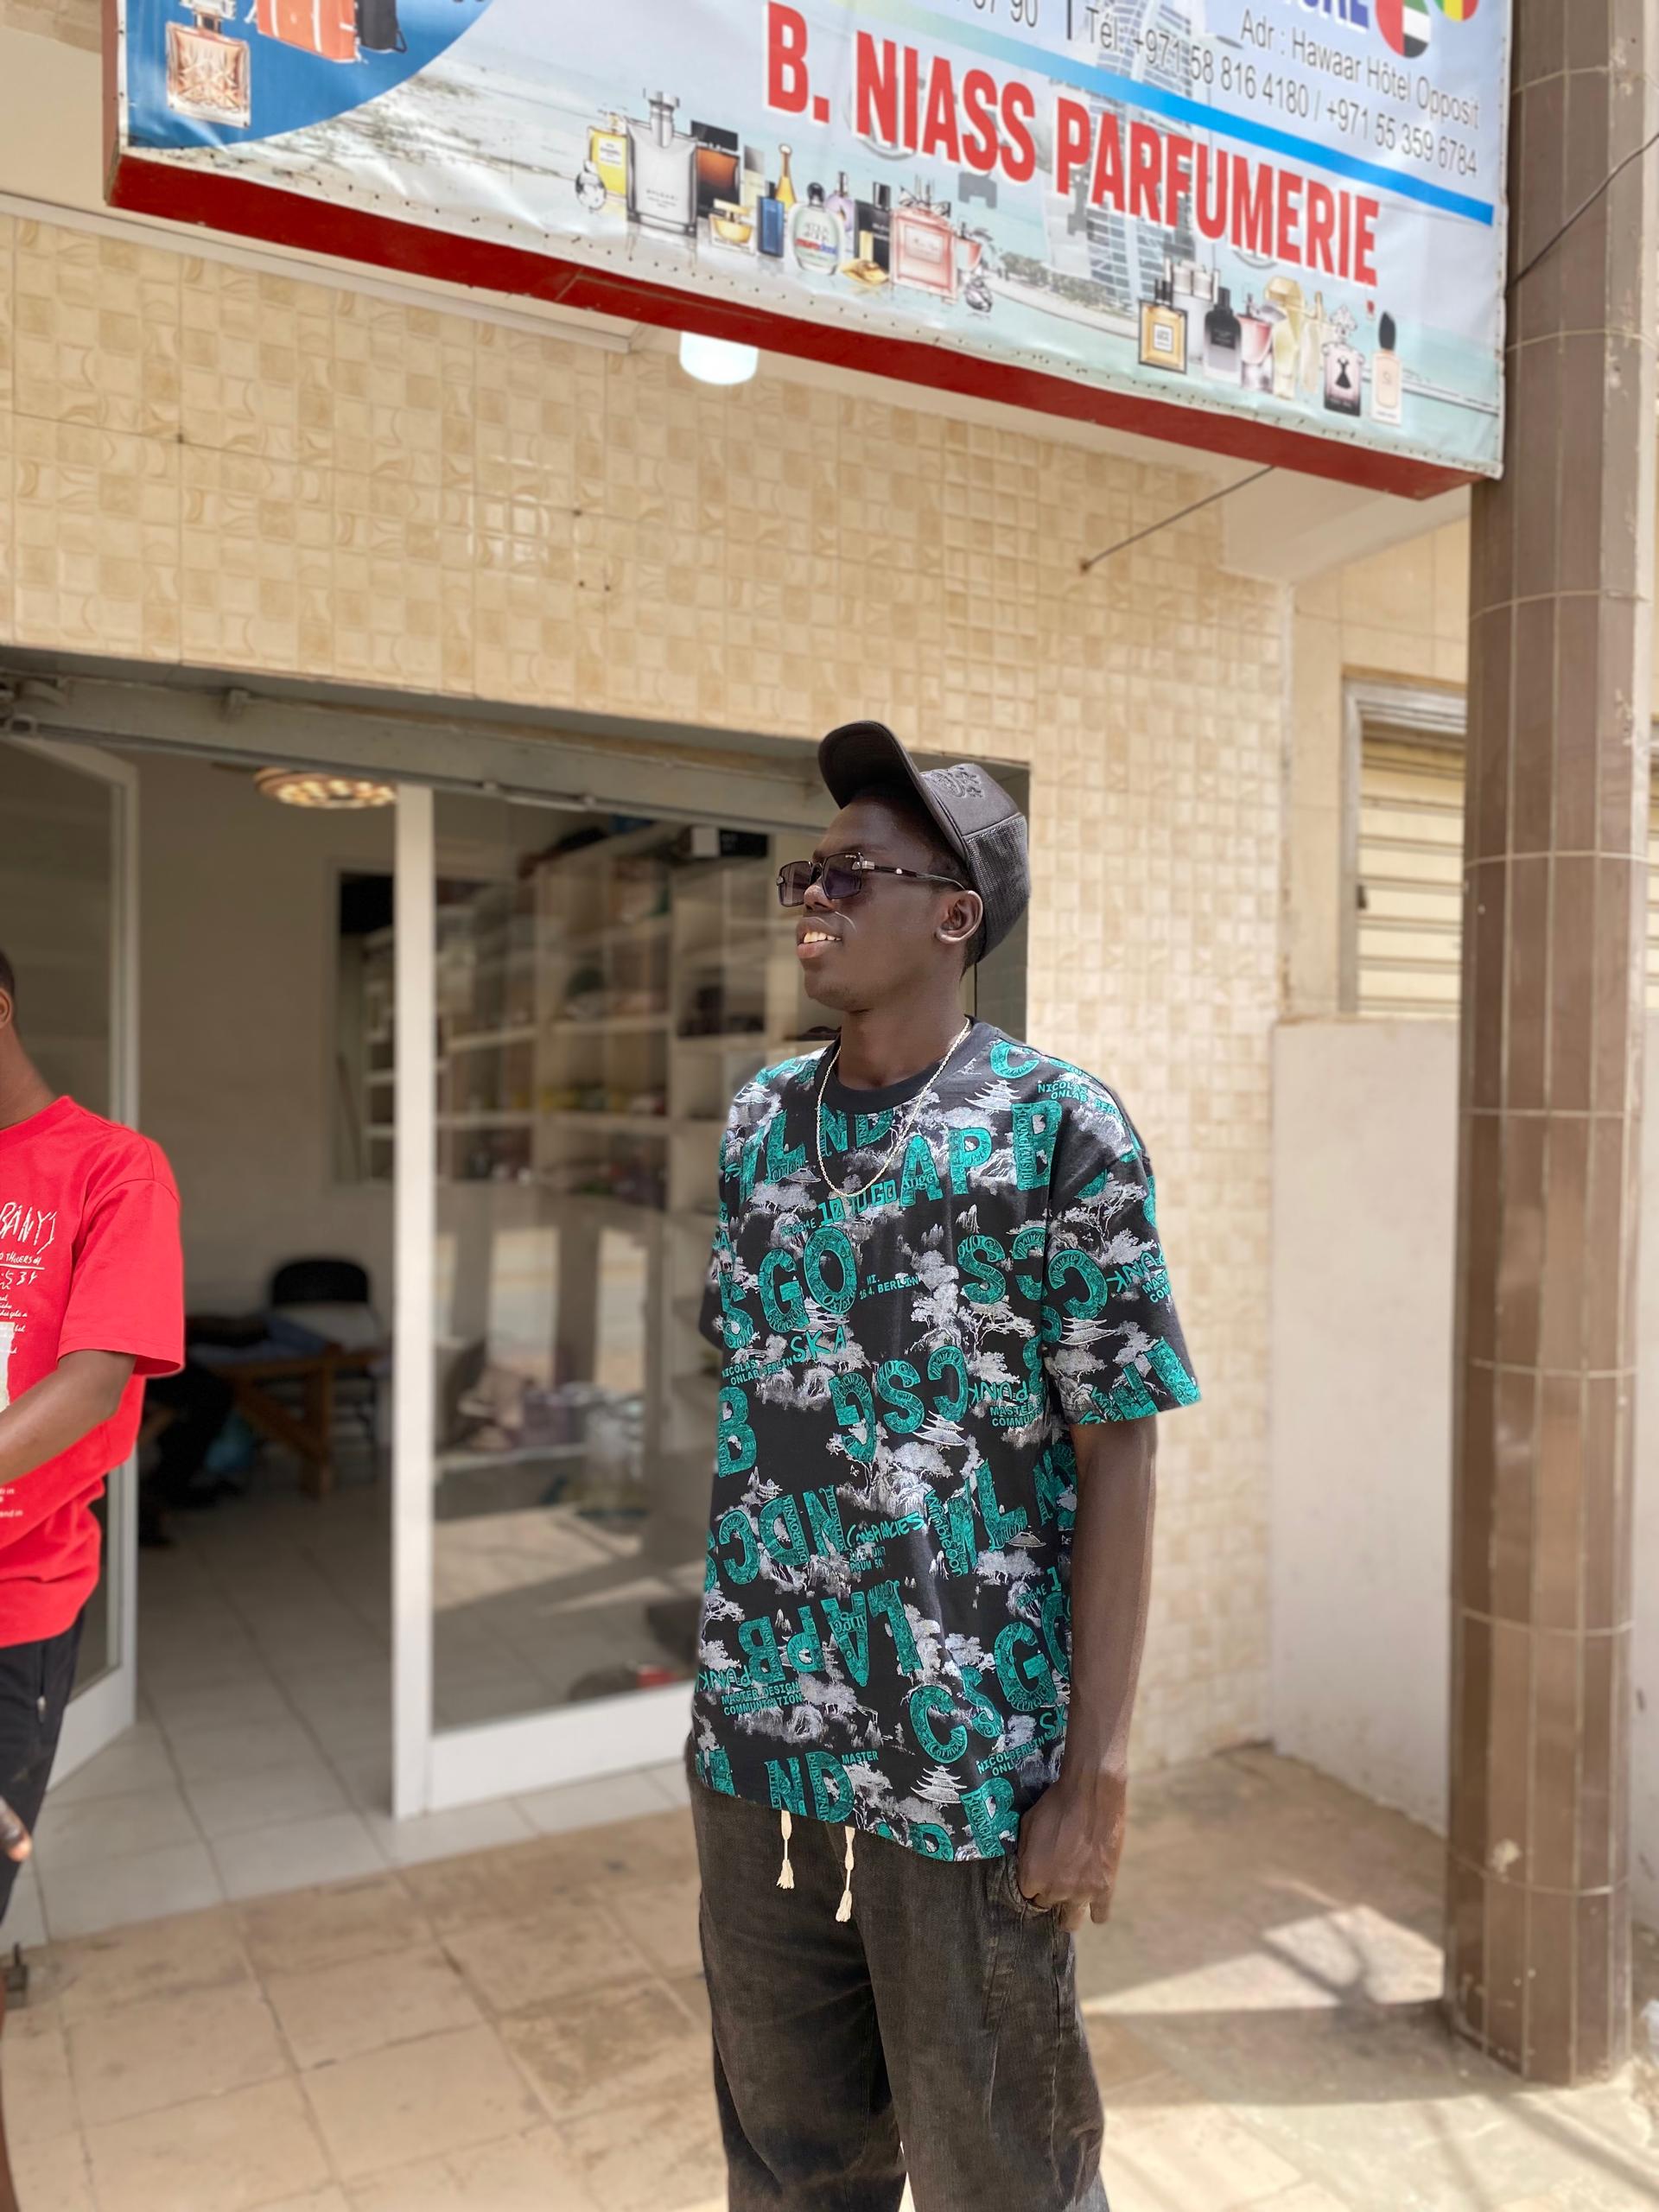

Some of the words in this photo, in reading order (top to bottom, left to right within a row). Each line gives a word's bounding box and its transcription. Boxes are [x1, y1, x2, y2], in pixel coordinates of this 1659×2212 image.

[1241, 9, 1274, 50] Adr
[1292, 26, 1362, 82] Hawaar
[1366, 55, 1412, 103] Hôtel
[1133, 29, 1181, 73] +971
[1191, 45, 1214, 85] 58
[1220, 55, 1256, 100] 816
[1262, 73, 1309, 118] 4180
[1326, 98, 1369, 140] +971
[1376, 113, 1396, 151] 55
[1402, 123, 1433, 162] 359
[1439, 135, 1478, 178] 6784
[767, 1, 830, 124] B.
[856, 29, 1036, 183] NIASS
[1056, 96, 1381, 288] PARFUMERIE
[1038, 1081, 1088, 1095] NICOLAS
[1051, 1090, 1088, 1103] ONLAB
[877, 1275, 919, 1294] BERLIN
[791, 1325, 848, 1363] SKA
[730, 1371, 760, 1386] ONLAB
[721, 1688, 759, 1706] MASTER
[764, 1681, 799, 1697] DESIGN
[723, 1693, 803, 1716] COMMUNICATION
[842, 1751, 879, 1764] MASTER
